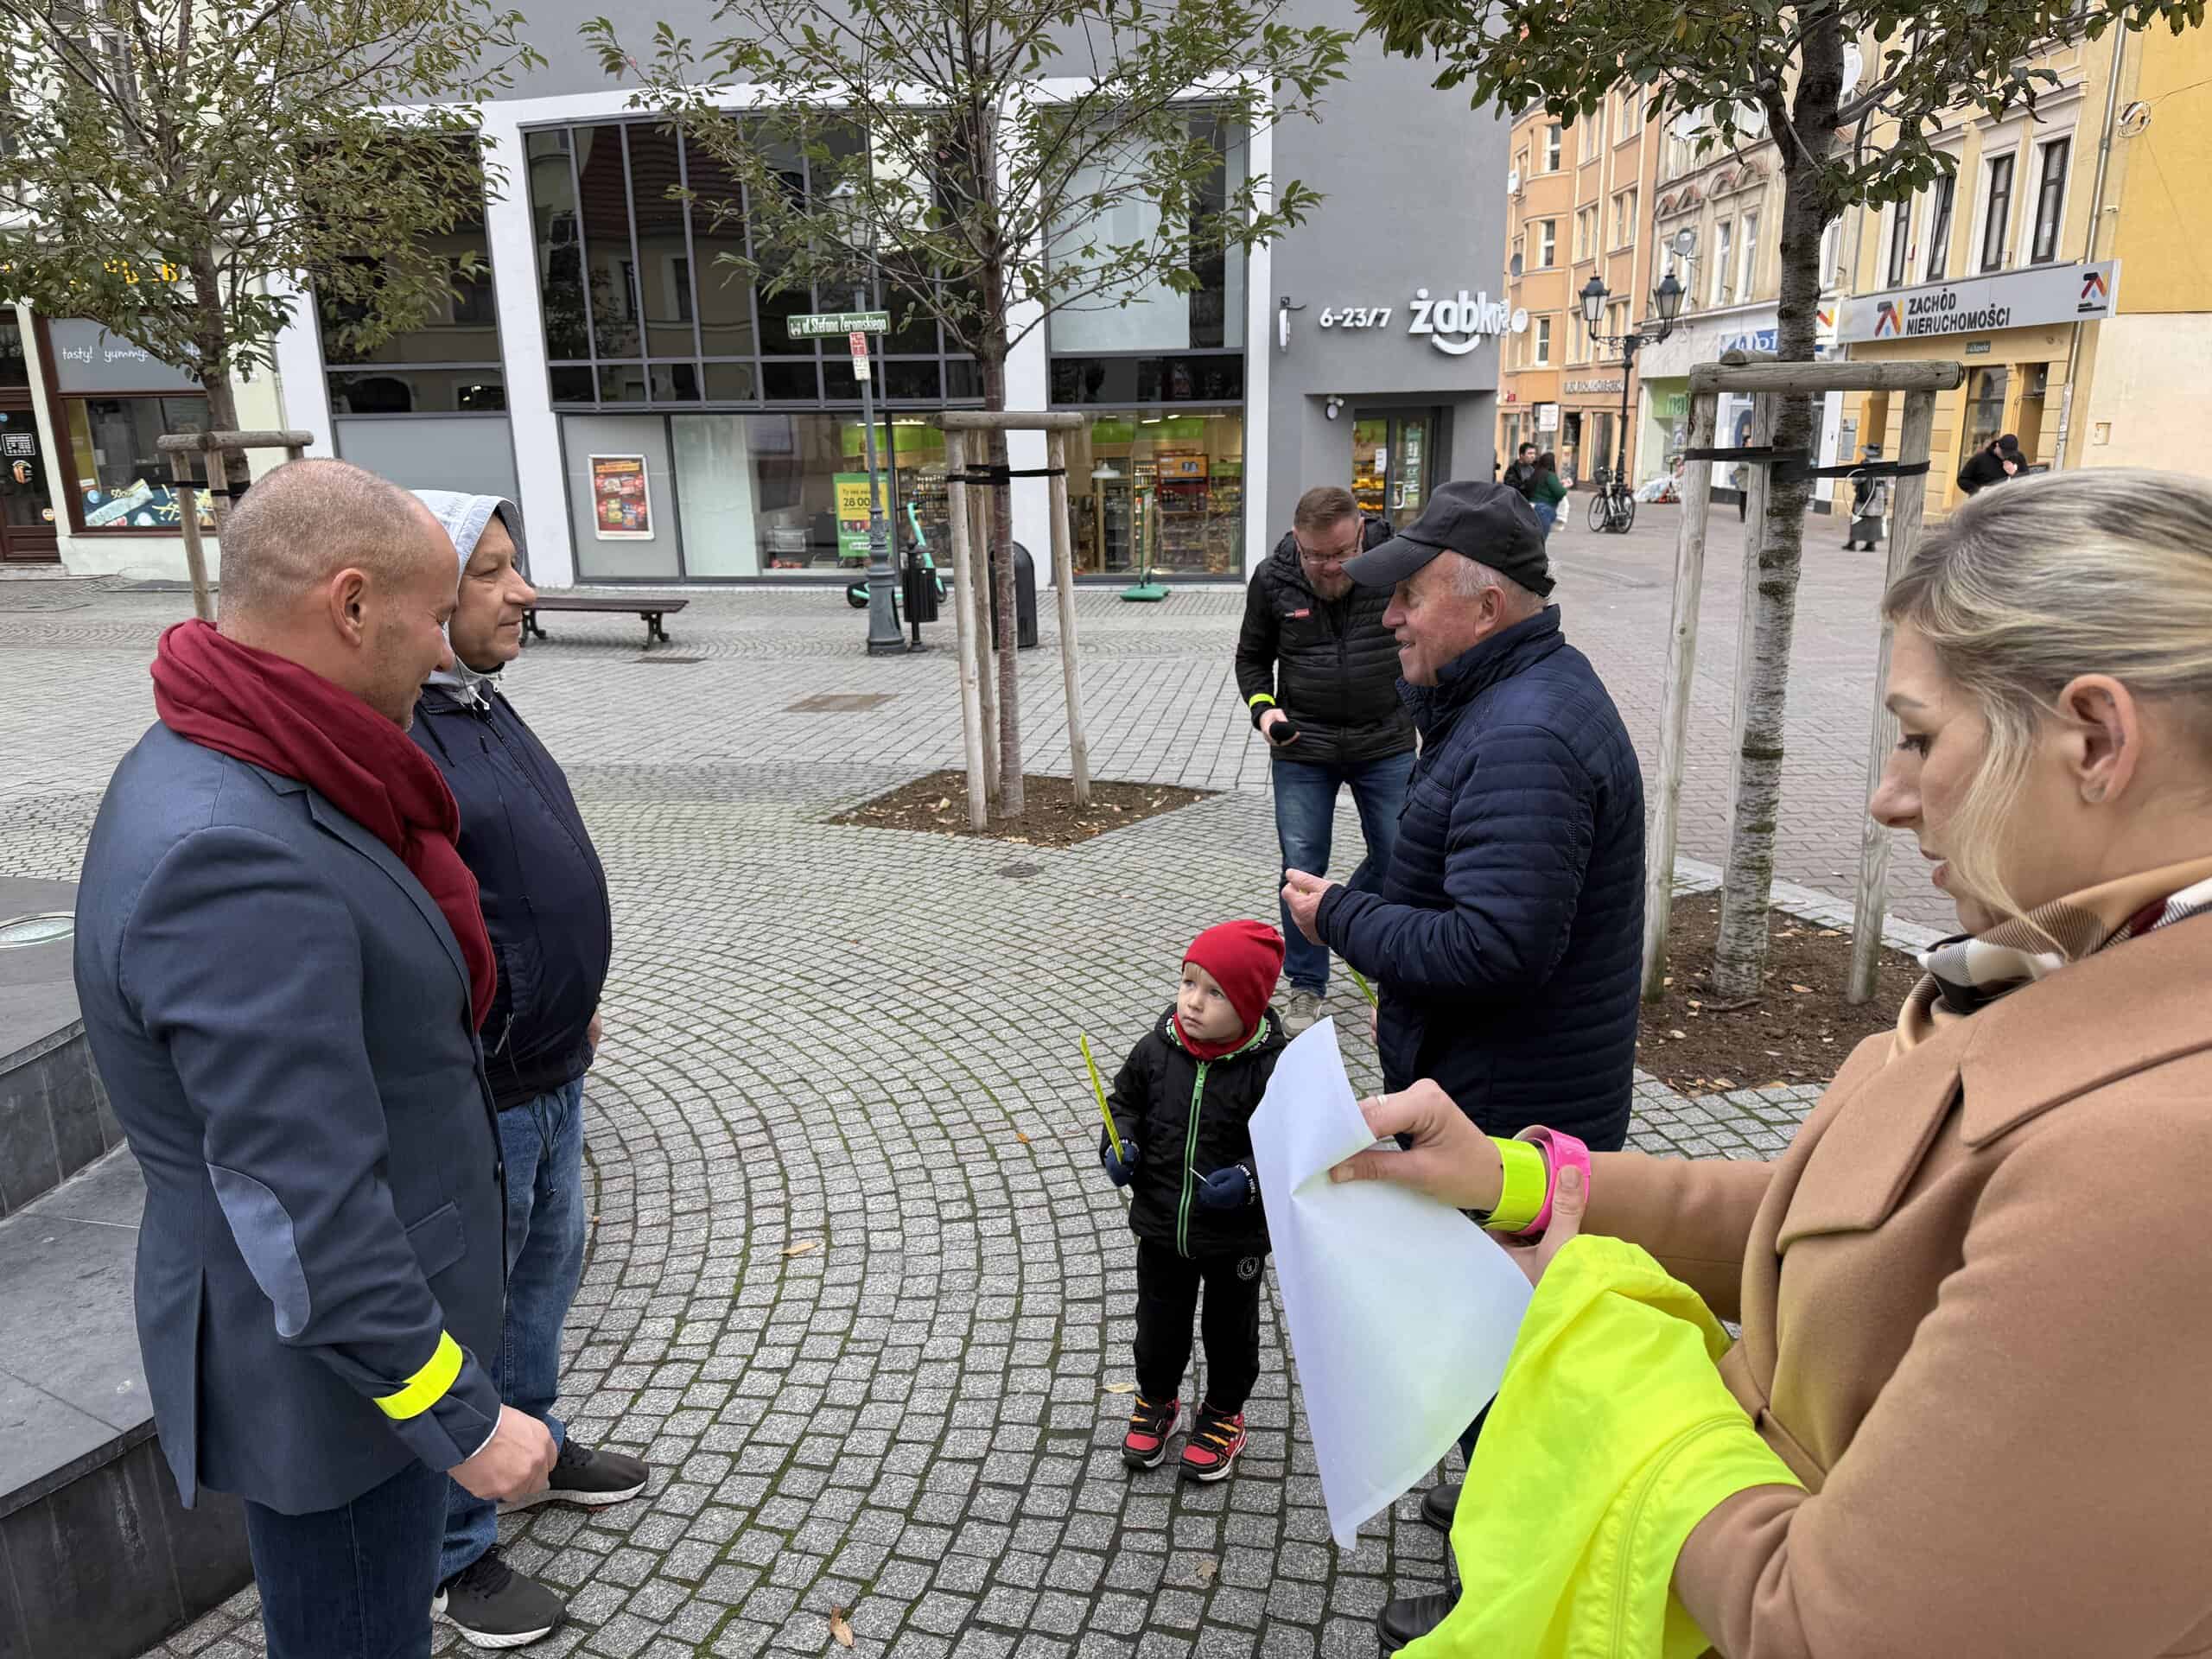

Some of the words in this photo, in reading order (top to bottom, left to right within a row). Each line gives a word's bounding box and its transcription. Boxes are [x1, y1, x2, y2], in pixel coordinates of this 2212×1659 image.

[1909, 288, 1956, 315] ZACHÓD
[1319, 308, 1392, 328] 6-23/7
[1907, 303, 2010, 335] NIERUCHOMOŚCI
[62, 346, 92, 363] tasty!
